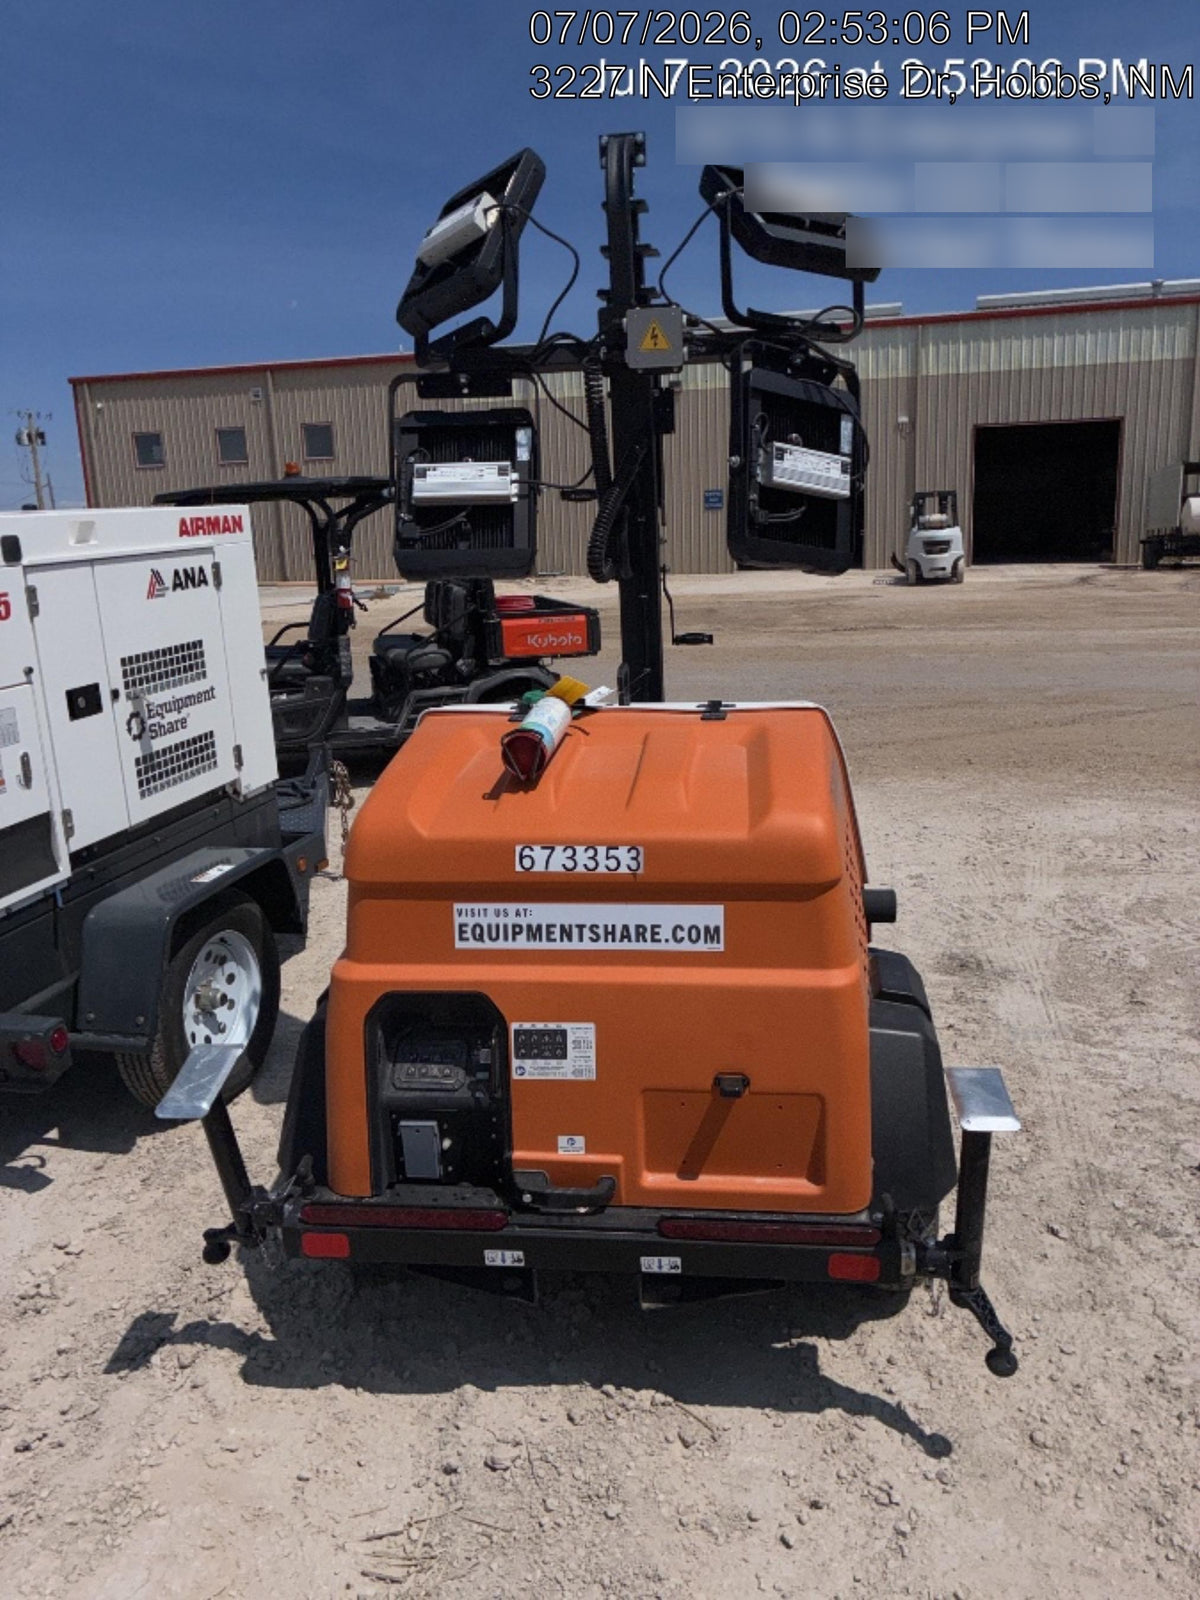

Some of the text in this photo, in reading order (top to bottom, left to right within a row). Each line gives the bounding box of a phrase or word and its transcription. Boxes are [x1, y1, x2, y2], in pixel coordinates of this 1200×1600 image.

[178, 515, 244, 538] AIRMAN
[172, 565, 209, 592] ANA
[527, 633, 583, 648] Kubota
[146, 685, 216, 720] Equipment
[149, 717, 188, 741] Share
[518, 846, 641, 872] 673353
[456, 908, 533, 918] VISIT US AT:
[457, 922, 721, 945] EQUIPMENTSHARE.COM
